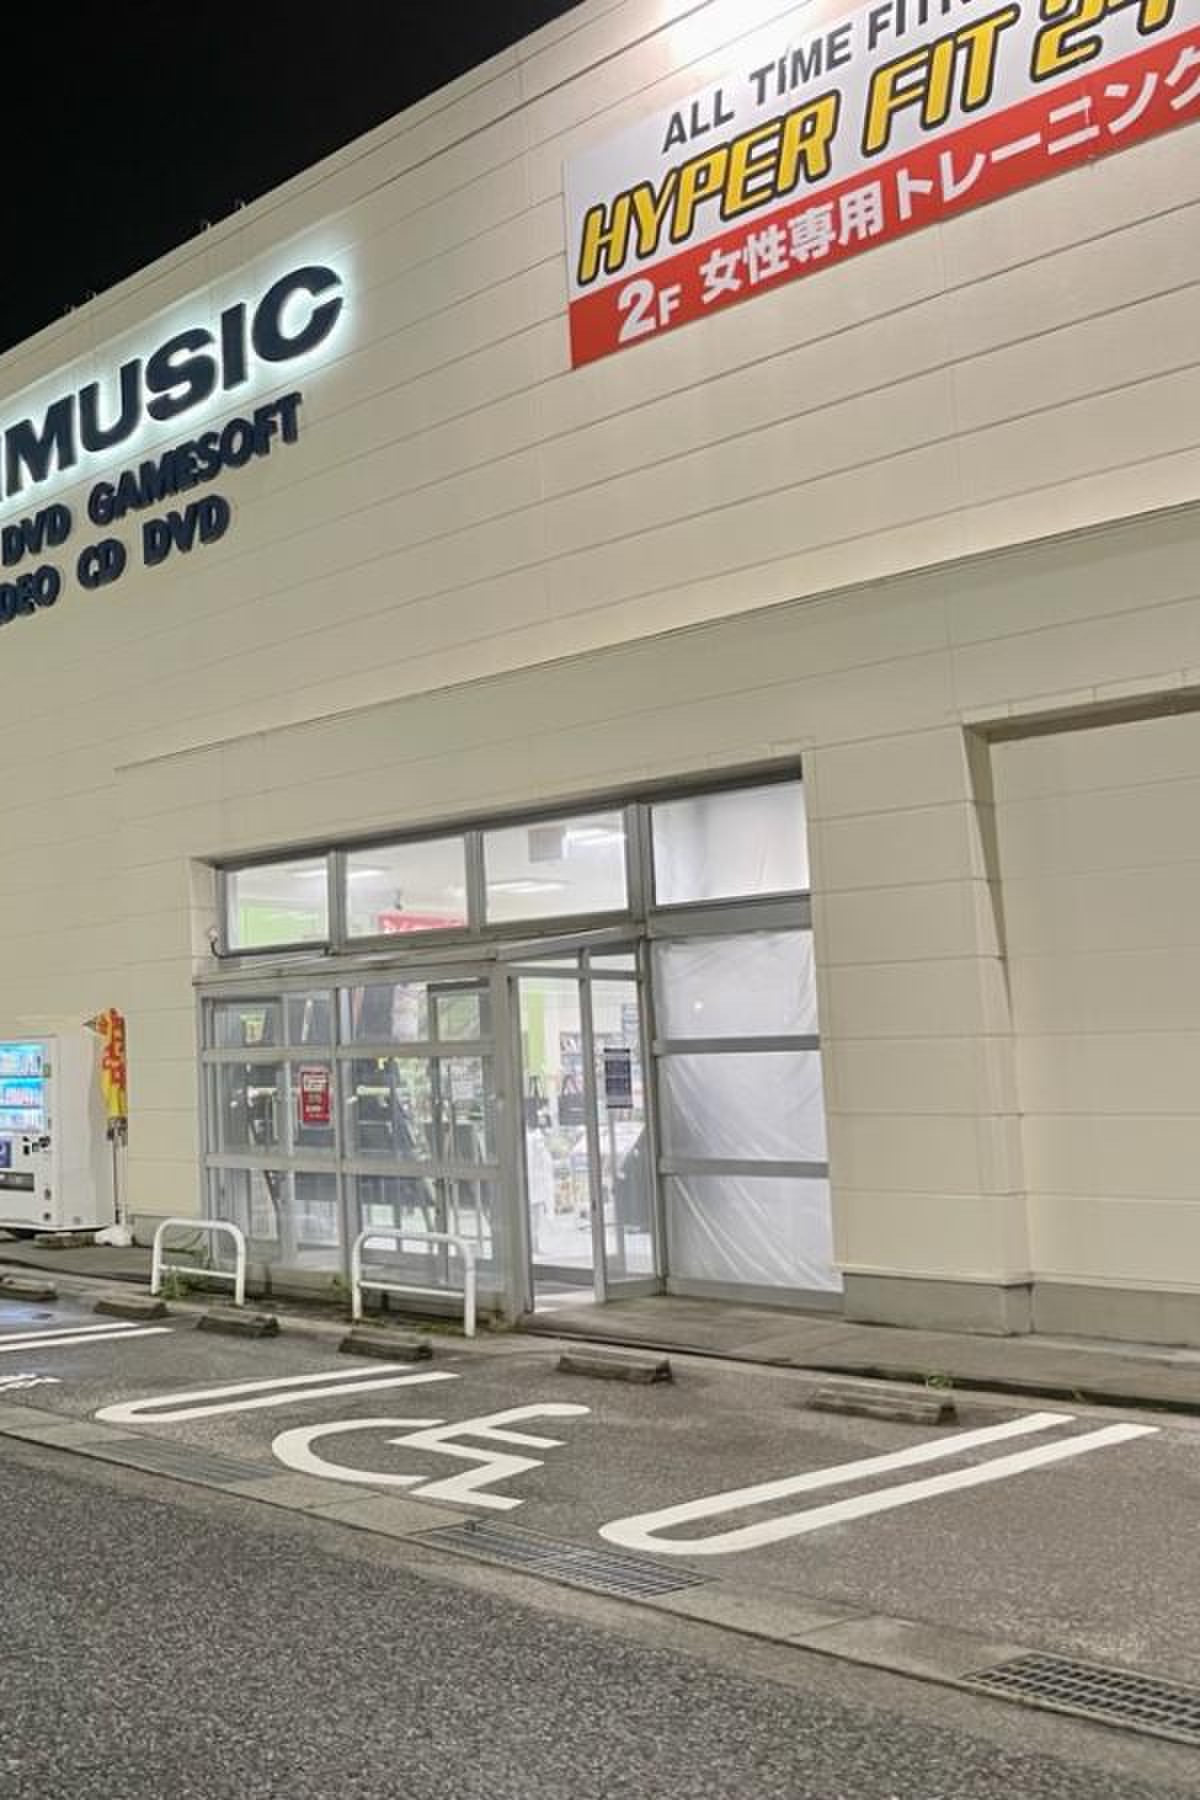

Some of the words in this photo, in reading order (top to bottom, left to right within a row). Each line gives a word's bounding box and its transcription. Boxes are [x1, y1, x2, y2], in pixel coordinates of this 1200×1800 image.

[577, 89, 841, 286] HYPER
[860, 3, 1021, 158] FIT
[662, 89, 735, 153] ALL
[749, 24, 853, 106] TIME
[867, 0, 963, 51] FI
[617, 278, 682, 343] 2F
[1, 503, 72, 567] DVD
[87, 391, 303, 526] GAMESOFT
[76, 538, 127, 590] CD
[141, 493, 231, 567] DVD
